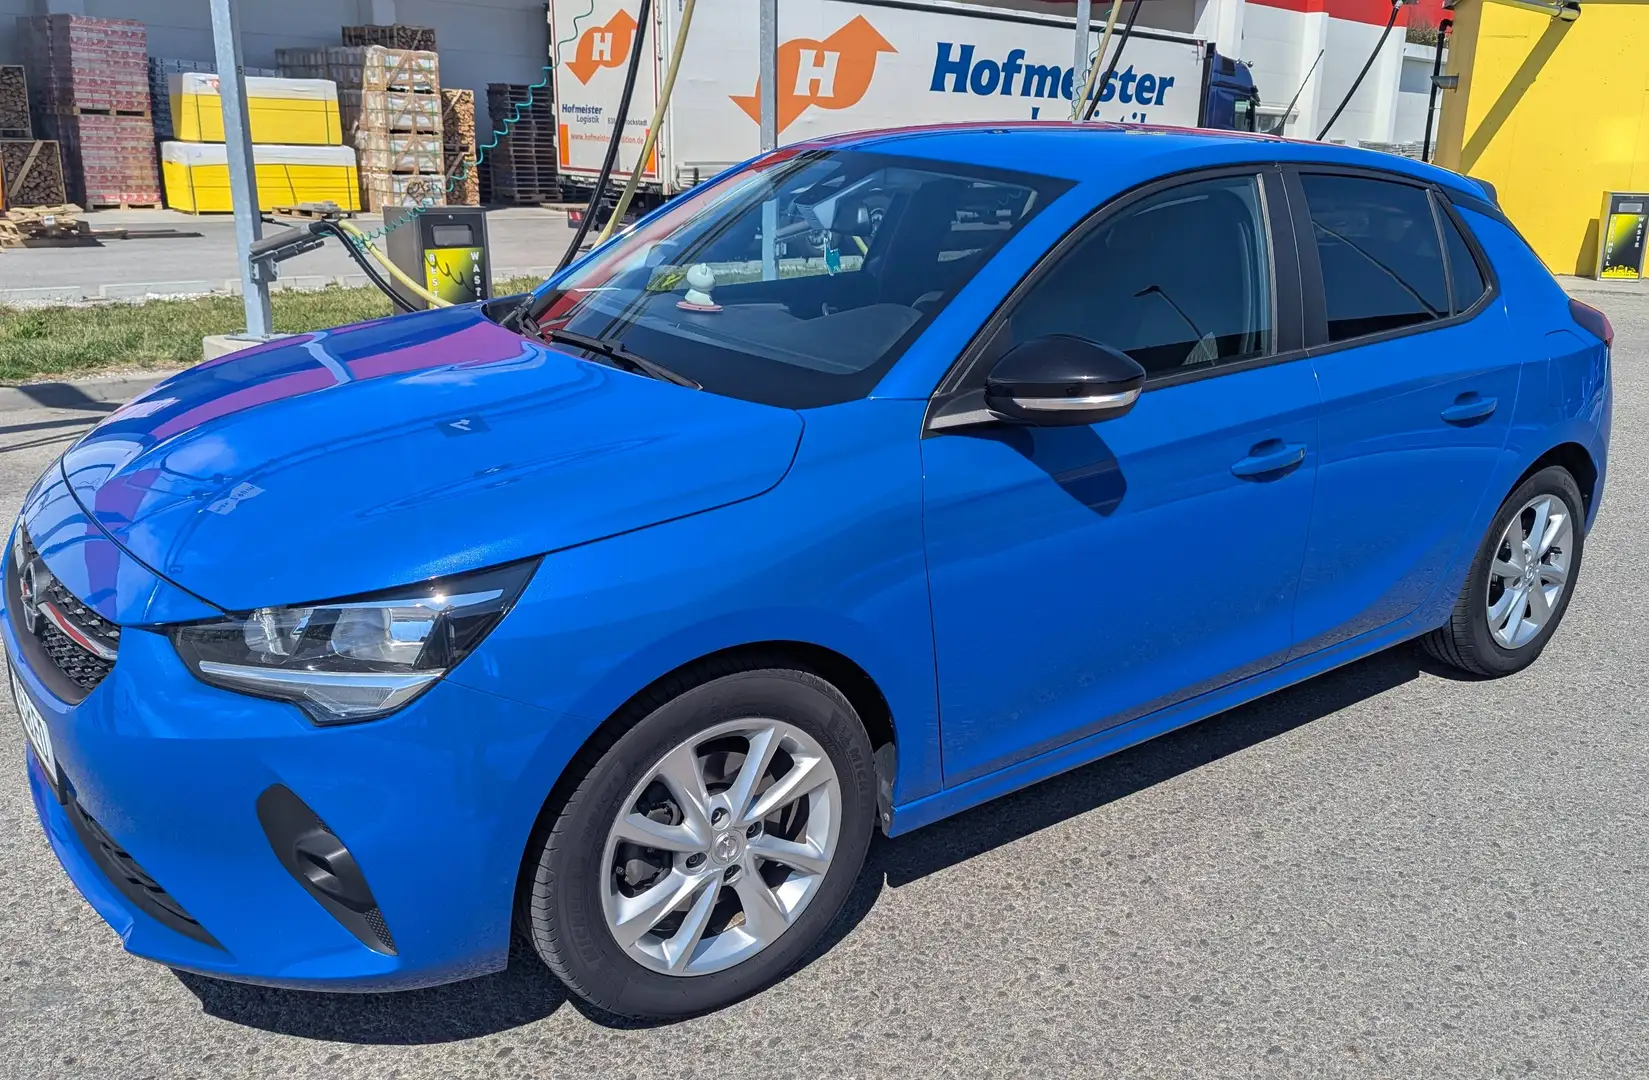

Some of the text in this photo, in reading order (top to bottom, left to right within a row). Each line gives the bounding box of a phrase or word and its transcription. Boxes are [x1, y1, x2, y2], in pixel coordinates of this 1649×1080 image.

[592, 32, 613, 61] H
[793, 48, 841, 98] H
[561, 103, 603, 115] Hofmeister
[576, 114, 600, 125] Logistik
[470, 251, 482, 302] WAST
